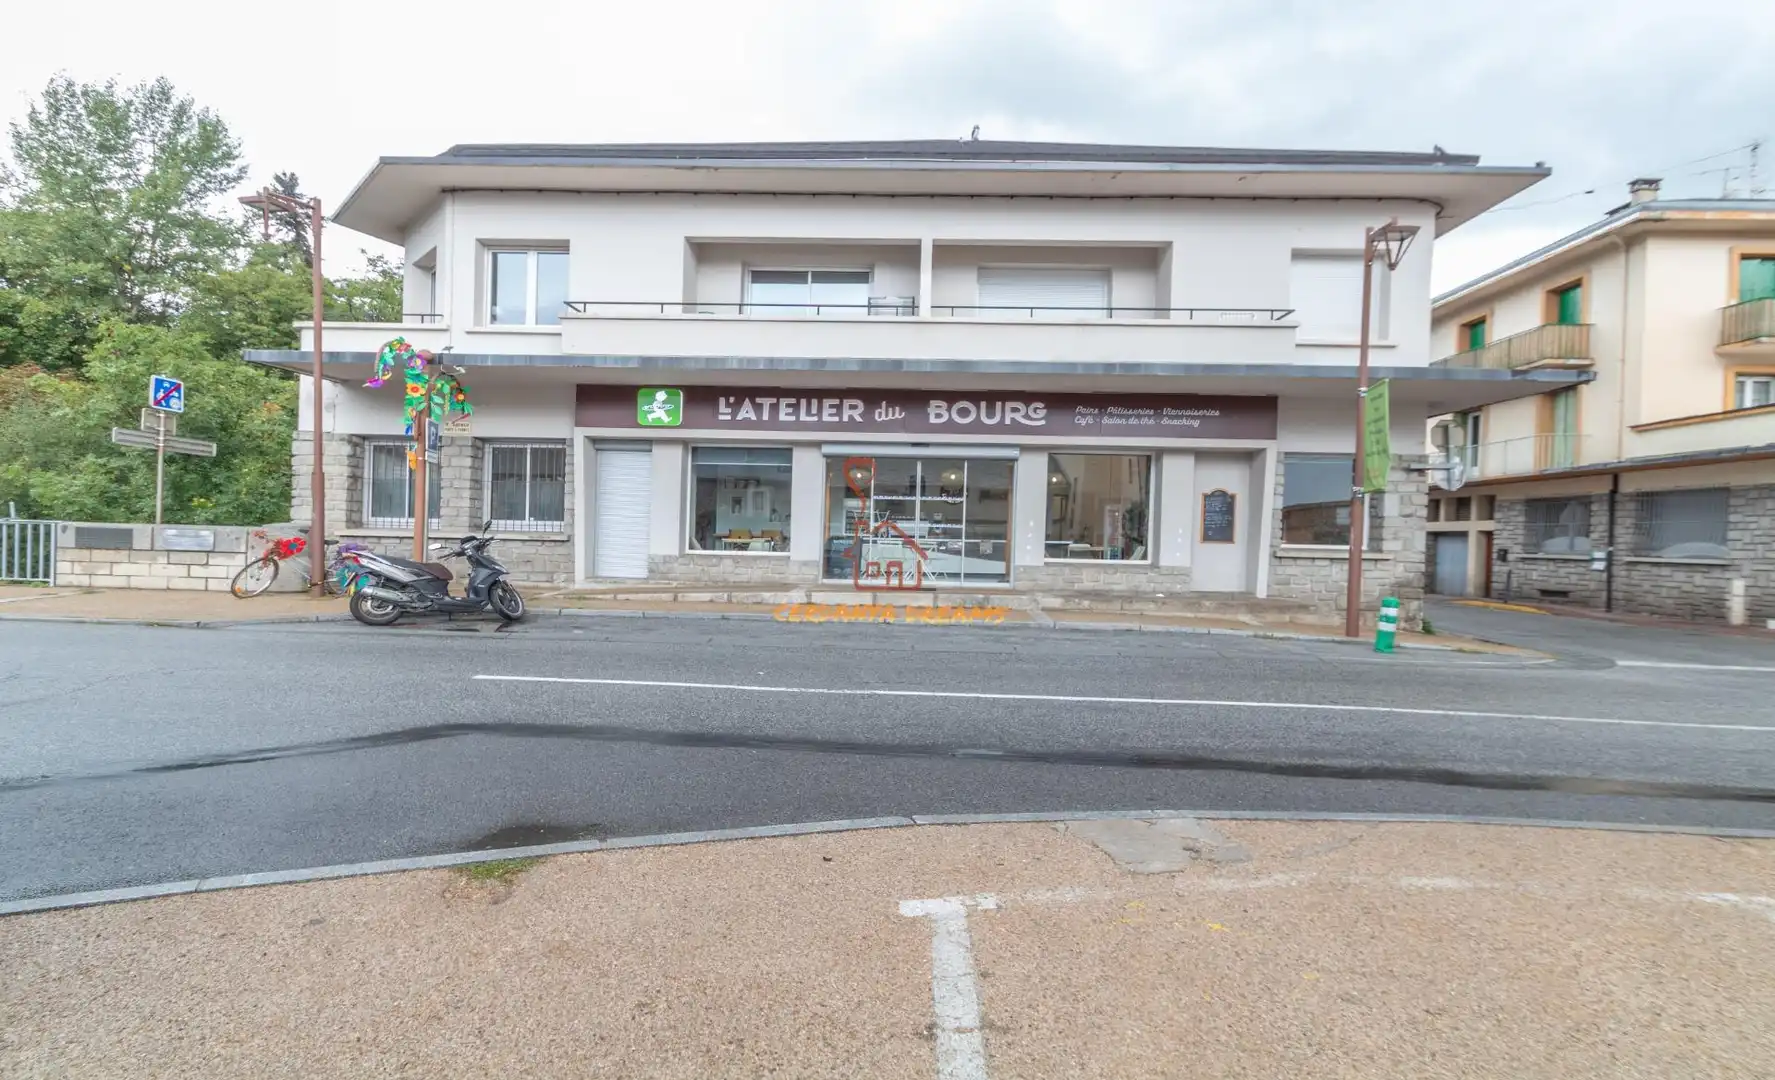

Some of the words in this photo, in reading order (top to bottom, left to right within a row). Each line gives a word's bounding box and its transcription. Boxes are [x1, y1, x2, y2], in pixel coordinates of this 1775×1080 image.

[718, 397, 864, 422] L'ATELIER
[874, 401, 905, 421] du
[927, 400, 1047, 426] BOURG
[1075, 406, 1099, 414] Pains
[1106, 405, 1155, 416] Pâtisseries
[1163, 407, 1220, 416] Viennoiseries
[1074, 415, 1094, 427] Café
[1101, 416, 1127, 425] Salon
[1127, 416, 1139, 425] de
[1140, 416, 1156, 425] thé
[1161, 416, 1201, 428] Snacking
